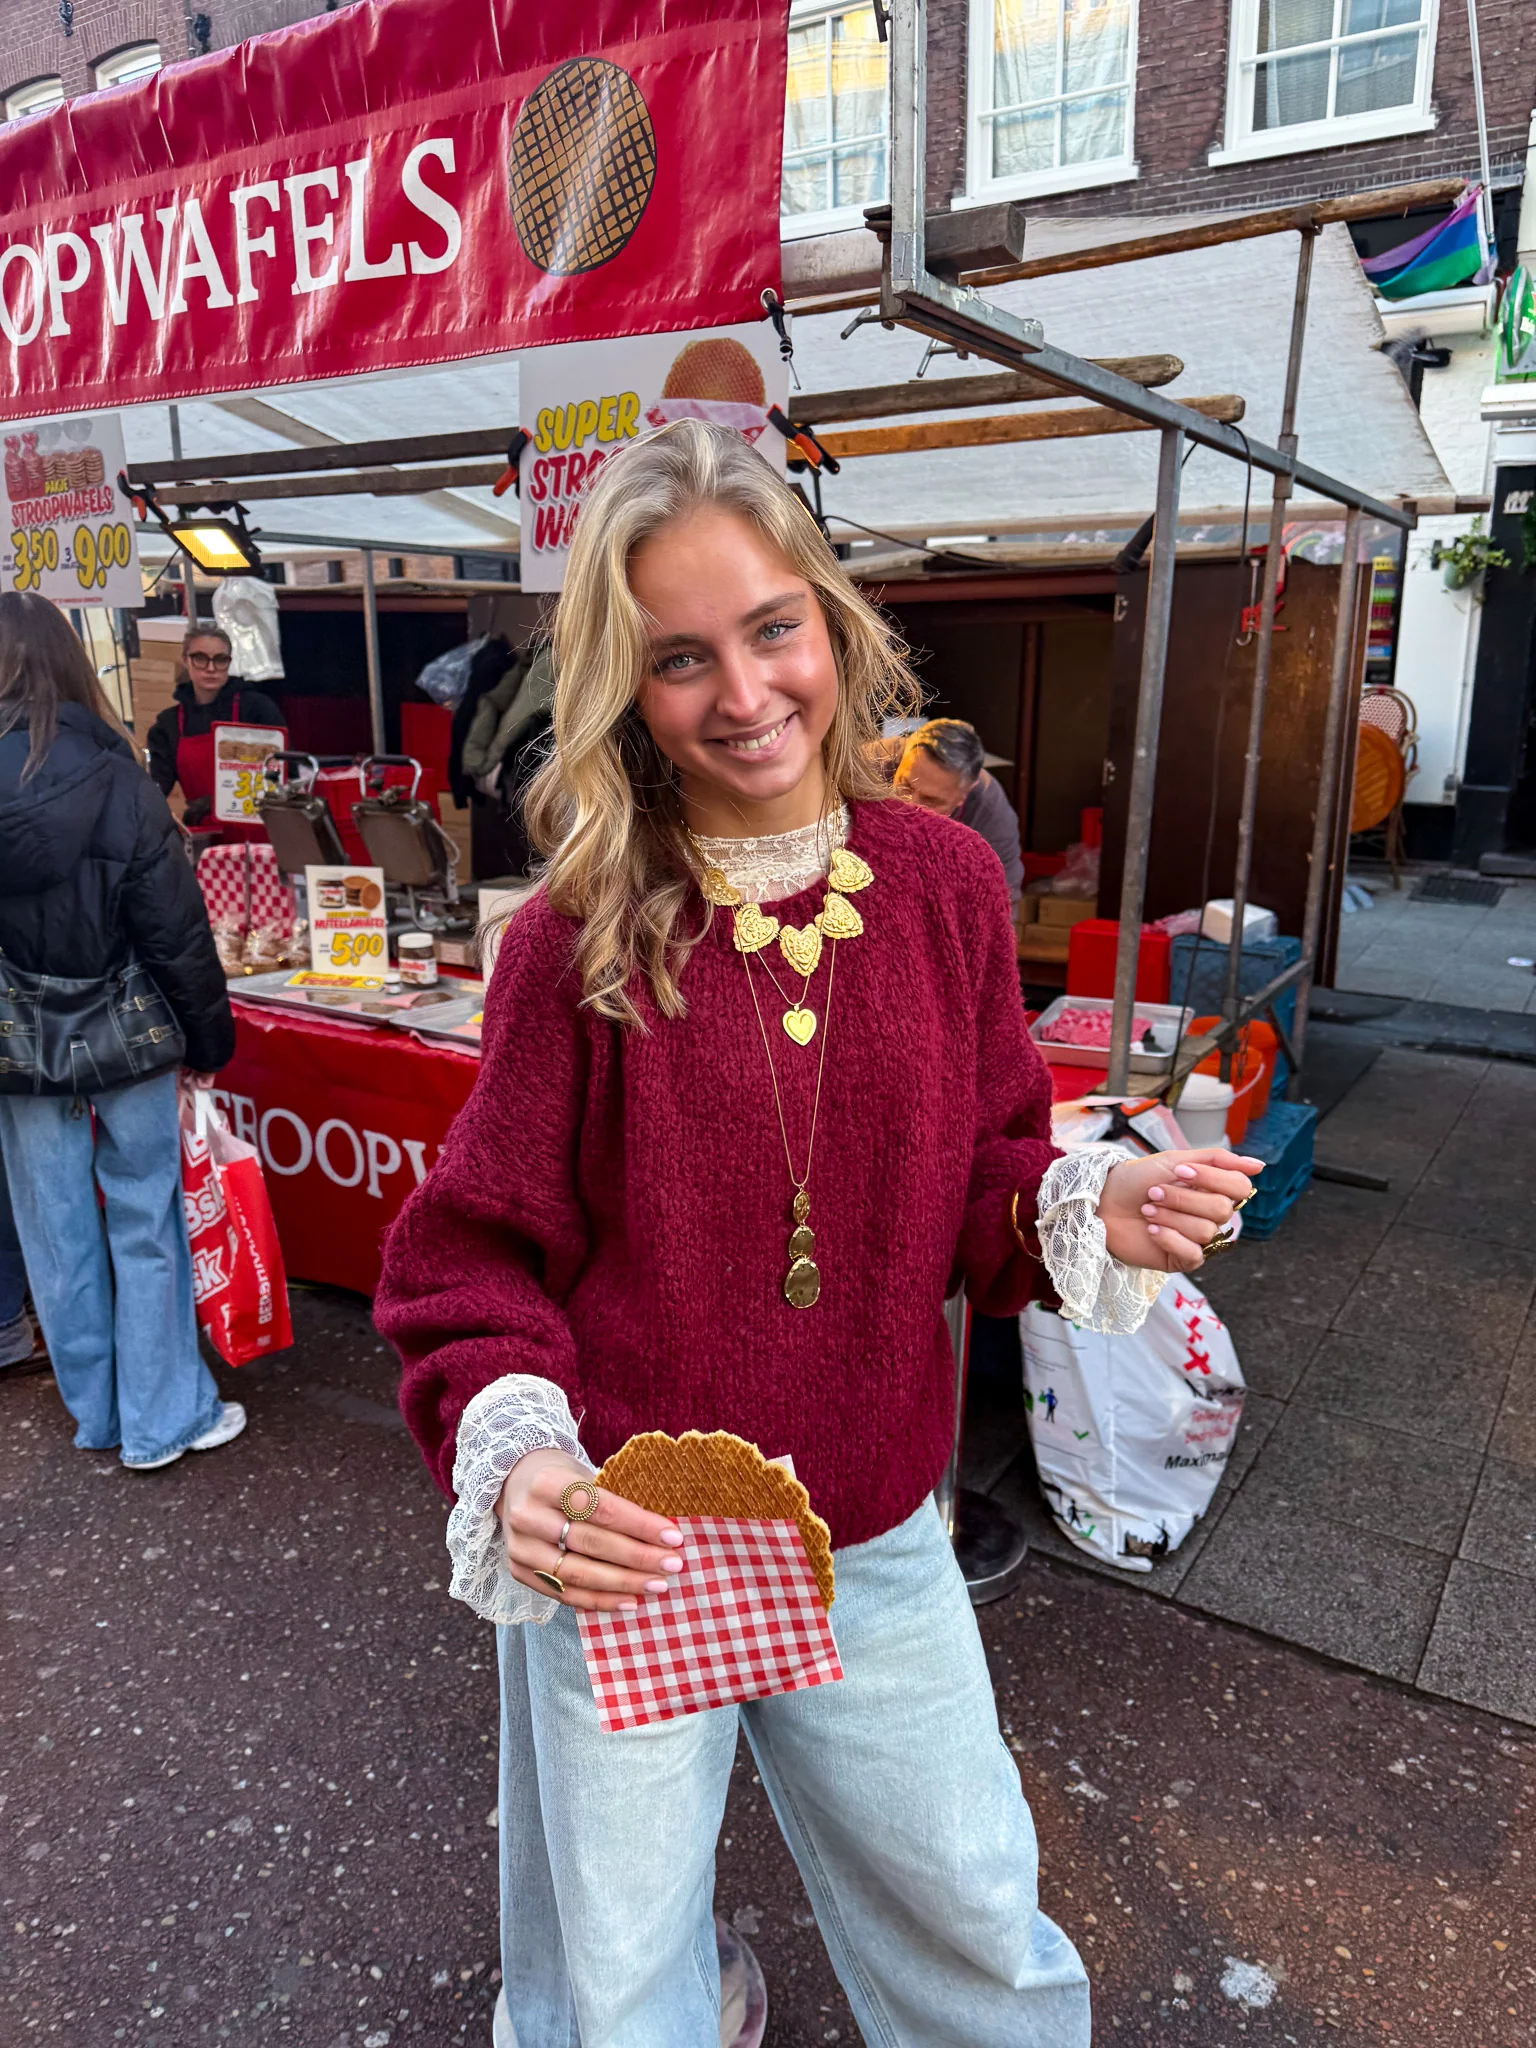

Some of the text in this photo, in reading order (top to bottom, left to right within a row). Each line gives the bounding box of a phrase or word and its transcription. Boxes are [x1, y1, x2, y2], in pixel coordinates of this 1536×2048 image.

[0, 137, 463, 347] OPWAFELS
[534, 391, 641, 453] SUPER
[530, 446, 623, 501] STRO
[11, 486, 113, 529] STROOPWAFELS
